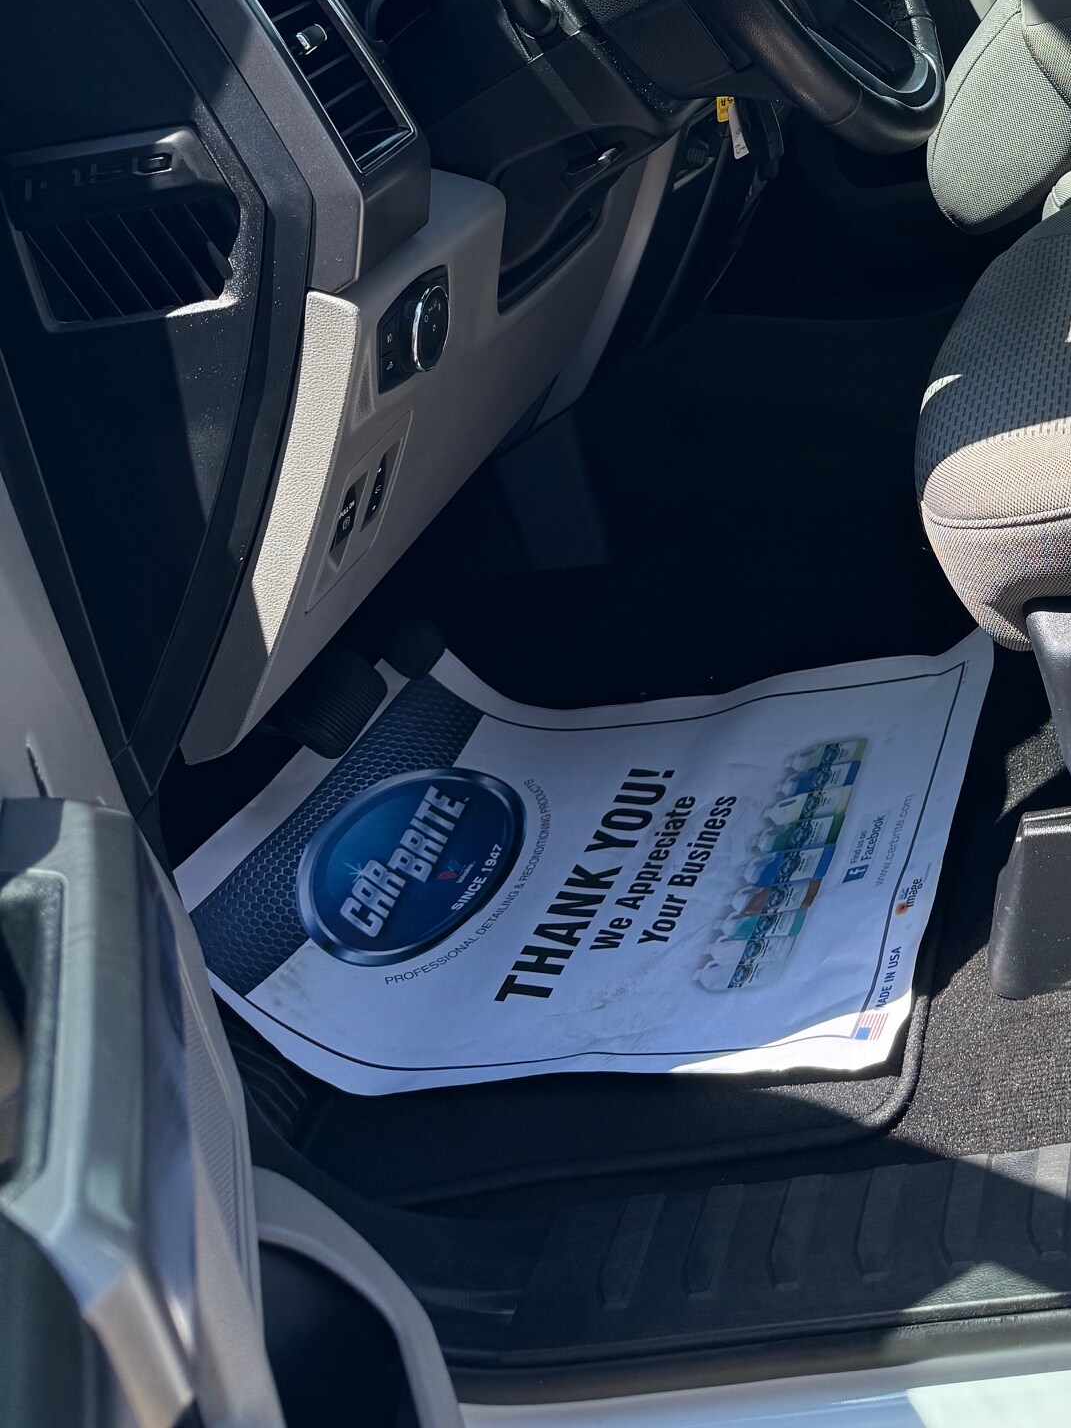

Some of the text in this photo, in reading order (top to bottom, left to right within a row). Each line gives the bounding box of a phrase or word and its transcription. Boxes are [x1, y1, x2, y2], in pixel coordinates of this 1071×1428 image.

[340, 785, 466, 938] CAR BRITE
[385, 778, 551, 985] PROFESSIONAL DETAILING & RECONDITIONING PRODUCTS
[451, 876, 487, 911] SINCE
[481, 844, 502, 876] 1947
[589, 795, 696, 950] We Appreciate
[637, 795, 737, 944] Your Business
[850, 830, 868, 864] Find us on
[860, 815, 885, 861] Facebook
[875, 794, 915, 887] www.carbrite.com
[494, 768, 675, 1002] THANK YOU!
[884, 970, 896, 983] IN
[888, 945, 902, 969] USA
